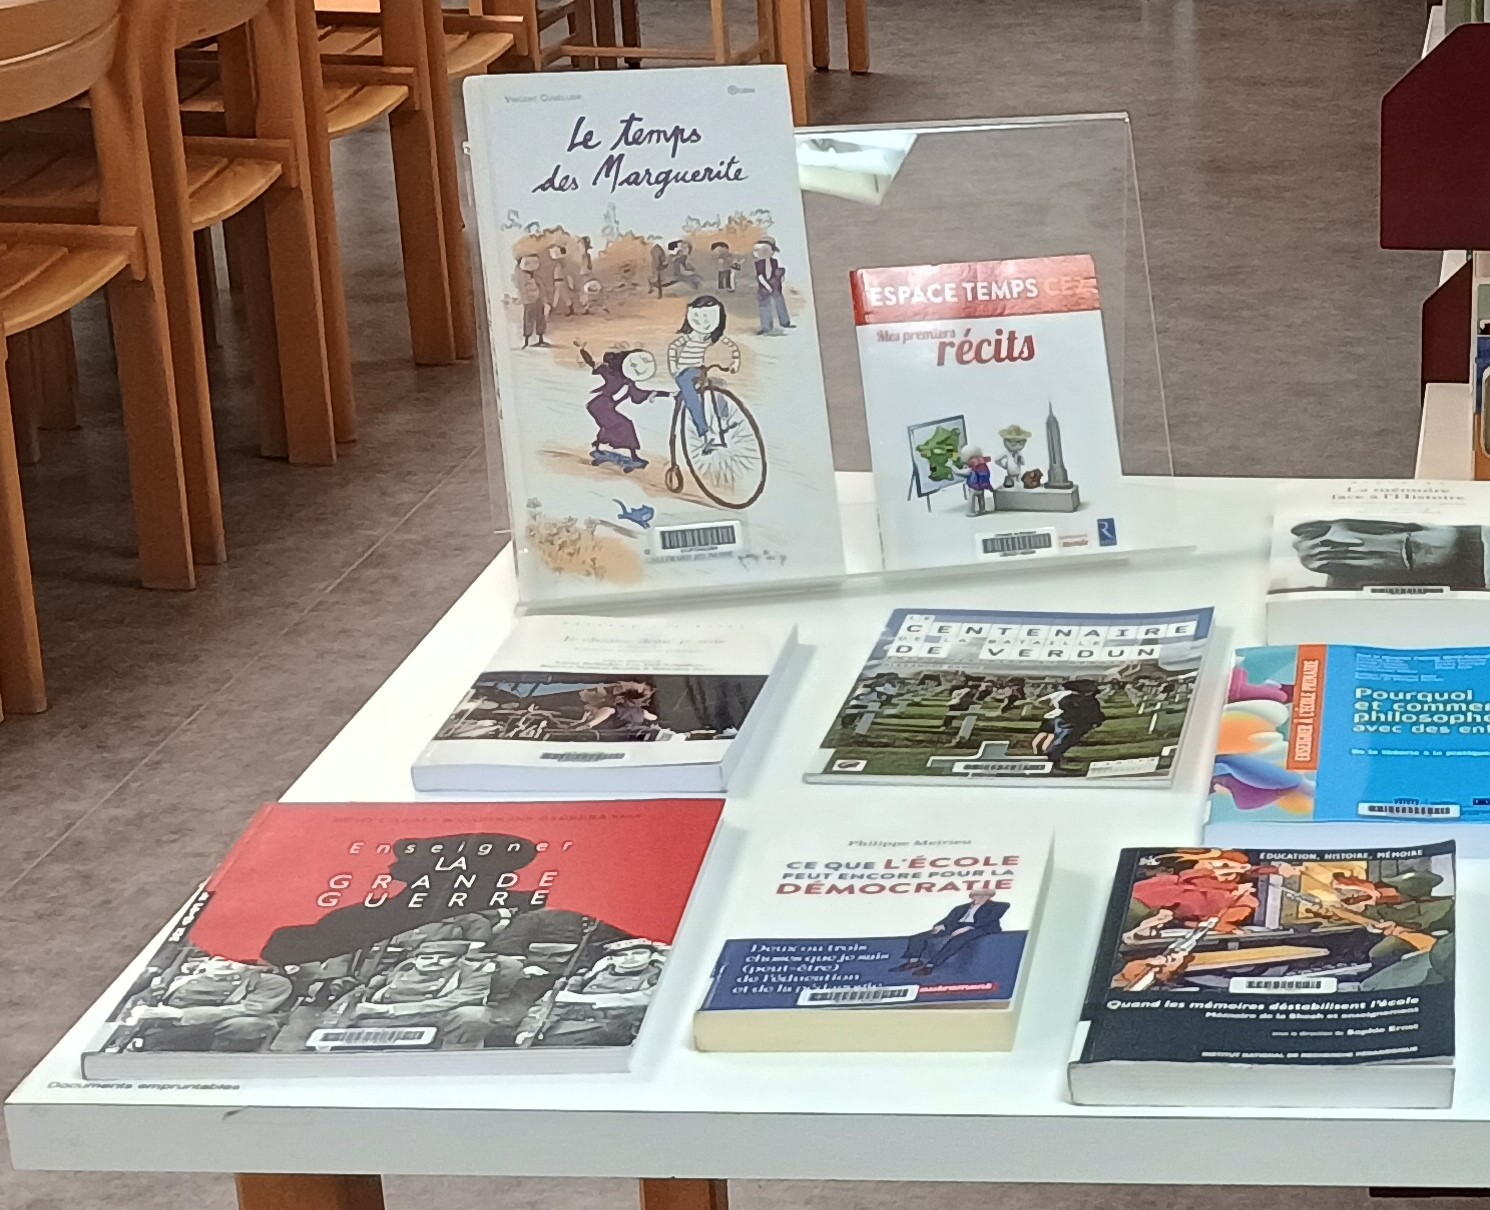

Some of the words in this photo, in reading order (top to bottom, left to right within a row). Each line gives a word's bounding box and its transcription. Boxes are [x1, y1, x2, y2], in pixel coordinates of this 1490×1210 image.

[566, 116, 602, 152] Le
[610, 113, 701, 158] temps
[531, 165, 579, 193] des
[592, 154, 749, 199] Marguerite
[870, 282, 958, 307] ESPACE
[962, 278, 1038, 301] TEMPS
[902, 329, 956, 344] premiers
[937, 328, 1036, 367] récits
[907, 623, 1188, 638] CENTENAIRE
[988, 638, 1101, 646] BATAILLE
[896, 645, 942, 655] DE
[987, 648, 1154, 658] VERDUN
[1355, 688, 1473, 702] Pourquoi
[1355, 701, 1382, 711] et
[1353, 724, 1402, 733] avec
[1412, 723, 1450, 734] des
[350, 841, 573, 855] Enseigner
[848, 839, 910, 848] Philippe
[1260, 851, 1319, 861] ÉDUCATION,
[1325, 851, 1371, 861] HISTOIRE,
[1377, 849, 1423, 859] MÉMOIRE
[435, 856, 467, 870] LA
[786, 861, 817, 870] CE
[824, 861, 876, 872] QUE
[884, 855, 1019, 870] L'ÉCOLE
[329, 871, 557, 889] GRANDE
[782, 872, 832, 880] PEUT
[838, 871, 922, 880] ENCORE
[928, 870, 984, 878] POUR
[776, 879, 1013, 895] DÉMOCRATIE
[317, 890, 549, 908] GUERRE
[751, 944, 798, 952] Deux
[828, 943, 867, 951] trois
[745, 954, 802, 962] choses
[805, 955, 837, 964] que
[857, 952, 889, 960] suis
[737, 974, 759, 983] de
[732, 984, 748, 994] et
[752, 984, 773, 993] de
[777, 984, 792, 993] la
[1107, 1000, 1161, 1010] Quand
[1164, 1000, 1185, 1008] les
[1189, 1001, 1265, 1010] mémoires
[1269, 1002, 1366, 1011] déstabilisent
[1370, 997, 1419, 1008] l'école
[47, 1081, 132, 1089] Documents
[138, 1082, 240, 1091] empruntables
